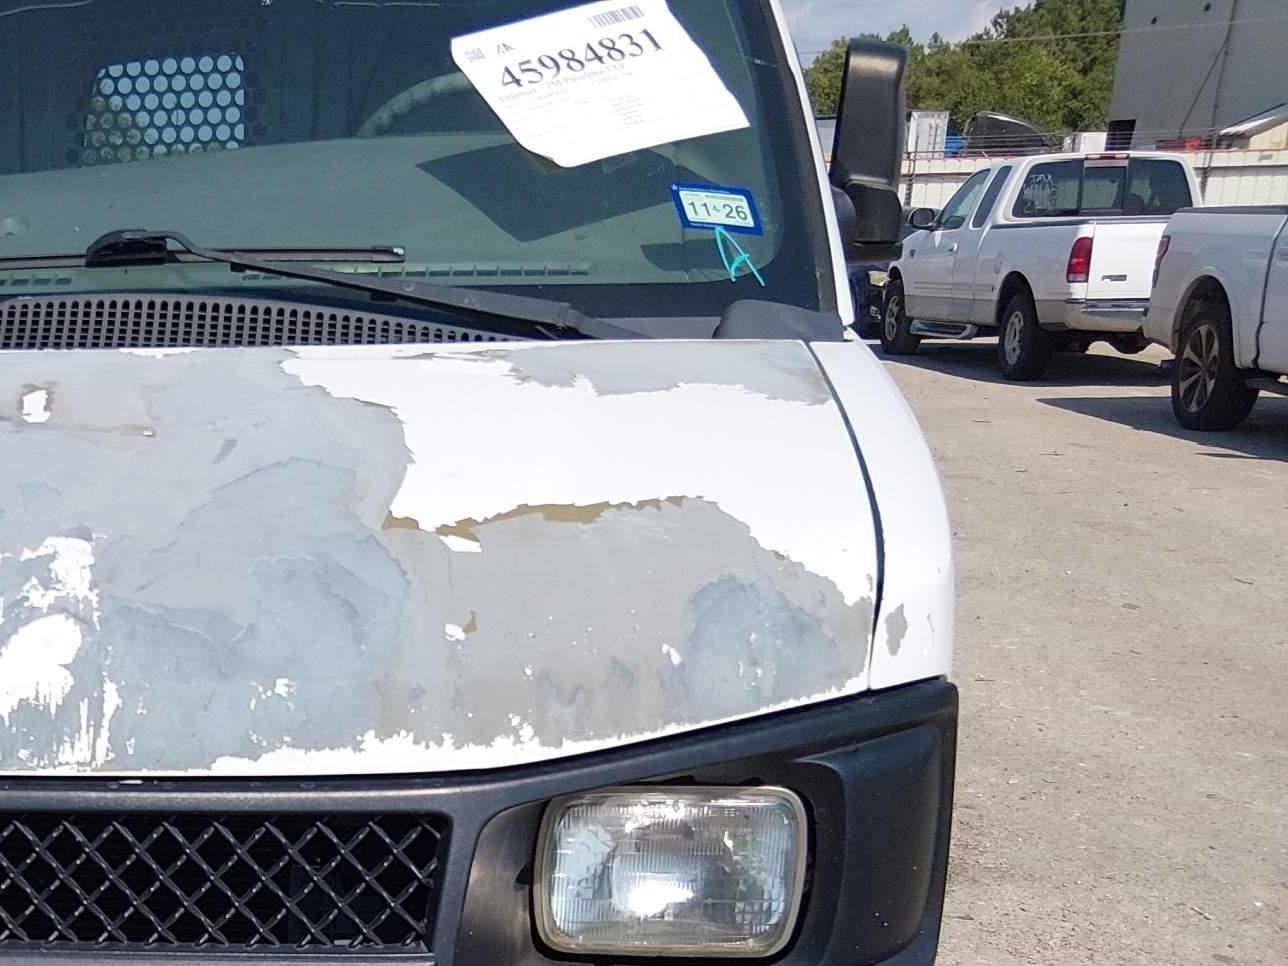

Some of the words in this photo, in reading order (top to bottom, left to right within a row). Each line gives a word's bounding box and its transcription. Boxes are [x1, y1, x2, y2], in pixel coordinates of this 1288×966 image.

[501, 28, 664, 88] 45984831
[688, 201, 711, 217] 11
[722, 204, 748, 221] 26
